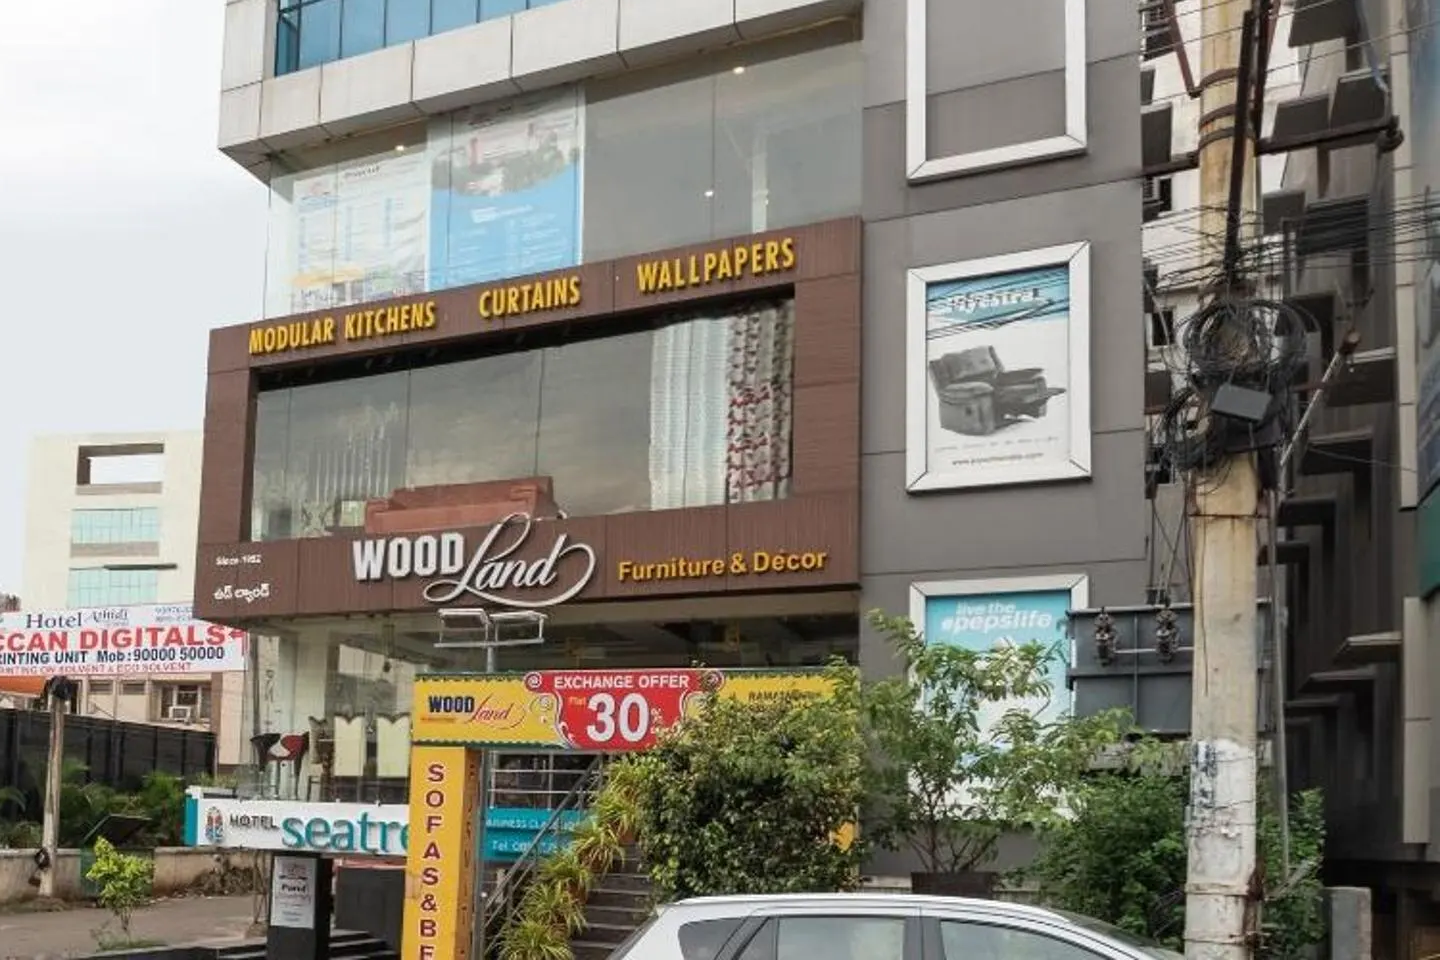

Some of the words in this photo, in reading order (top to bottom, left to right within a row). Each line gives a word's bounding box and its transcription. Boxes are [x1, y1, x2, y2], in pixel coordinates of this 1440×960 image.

[636, 237, 795, 292] WALLPAPERS
[479, 275, 581, 319] CURTAINS
[249, 317, 335, 354] MODULAR
[344, 300, 436, 340] KITCHENS
[352, 532, 465, 581] WOOD
[423, 512, 596, 607] Land
[618, 557, 726, 581] Furniture
[729, 552, 748, 574] &
[26, 612, 83, 629] Hotel
[955, 602, 986, 615] live
[988, 602, 1016, 615] the
[79, 625, 226, 650] DIGITALS
[54, 651, 88, 663] UNIT
[179, 646, 225, 662] 50000
[553, 675, 634, 689] EXCHANGE
[638, 675, 690, 689] OFFER
[428, 695, 475, 714] WOOD
[586, 692, 650, 742] 30
[229, 813, 280, 831] HOTEL
